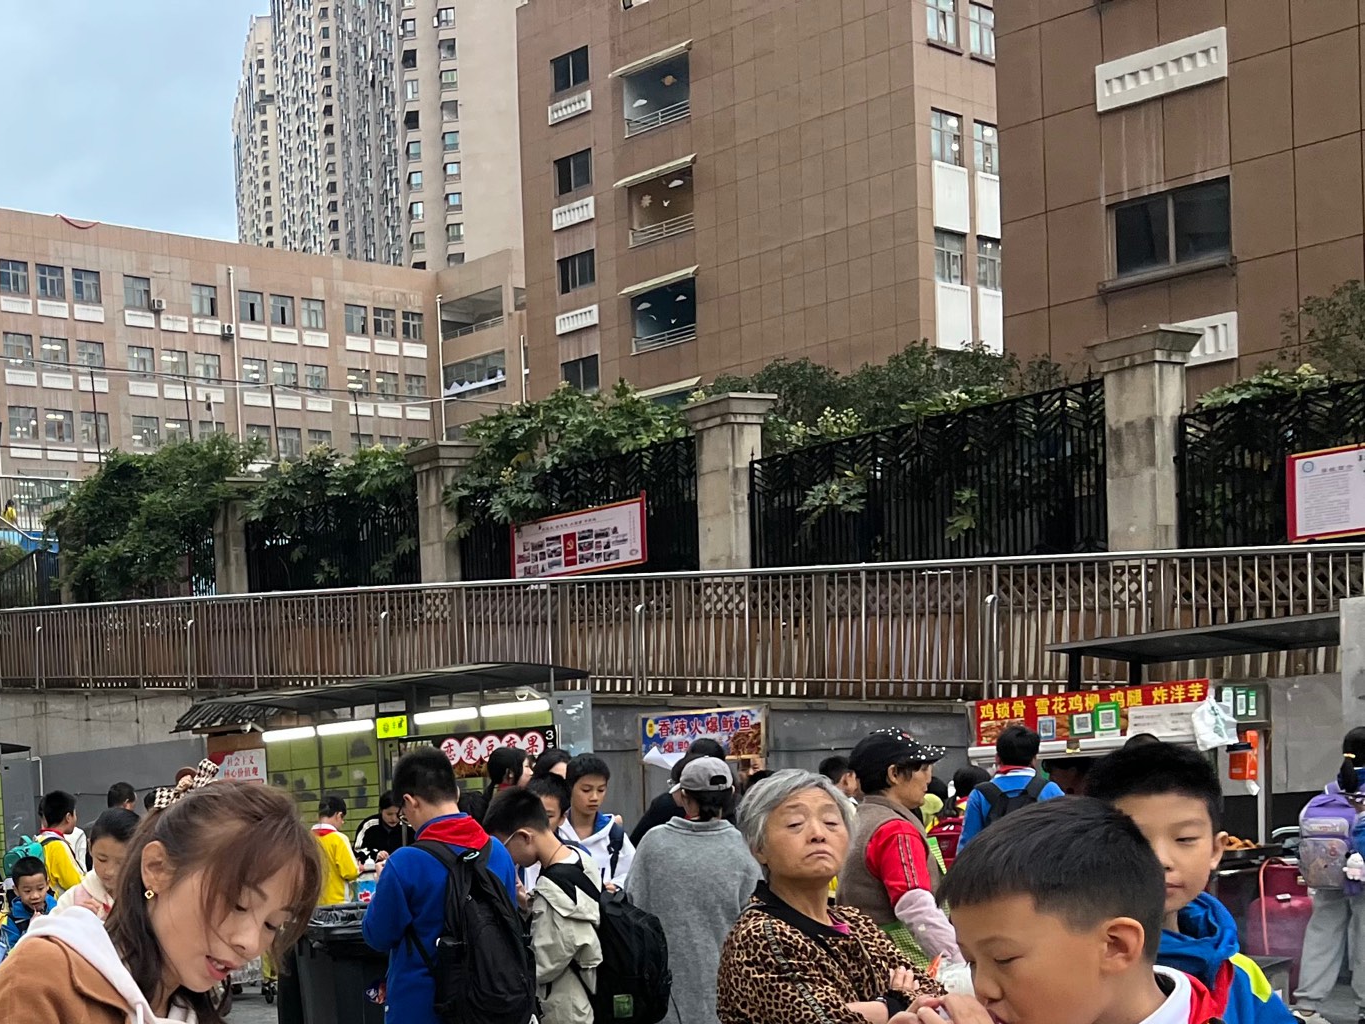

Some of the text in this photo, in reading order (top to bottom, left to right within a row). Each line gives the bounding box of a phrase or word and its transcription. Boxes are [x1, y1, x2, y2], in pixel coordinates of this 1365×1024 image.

[980, 700, 1026, 719] 鸡锁骨
[1035, 693, 1100, 716] 雪花鸡柳
[1152, 682, 1205, 704] 炸洋芋
[658, 714, 752, 738] 香辣火爆鱿鱼
